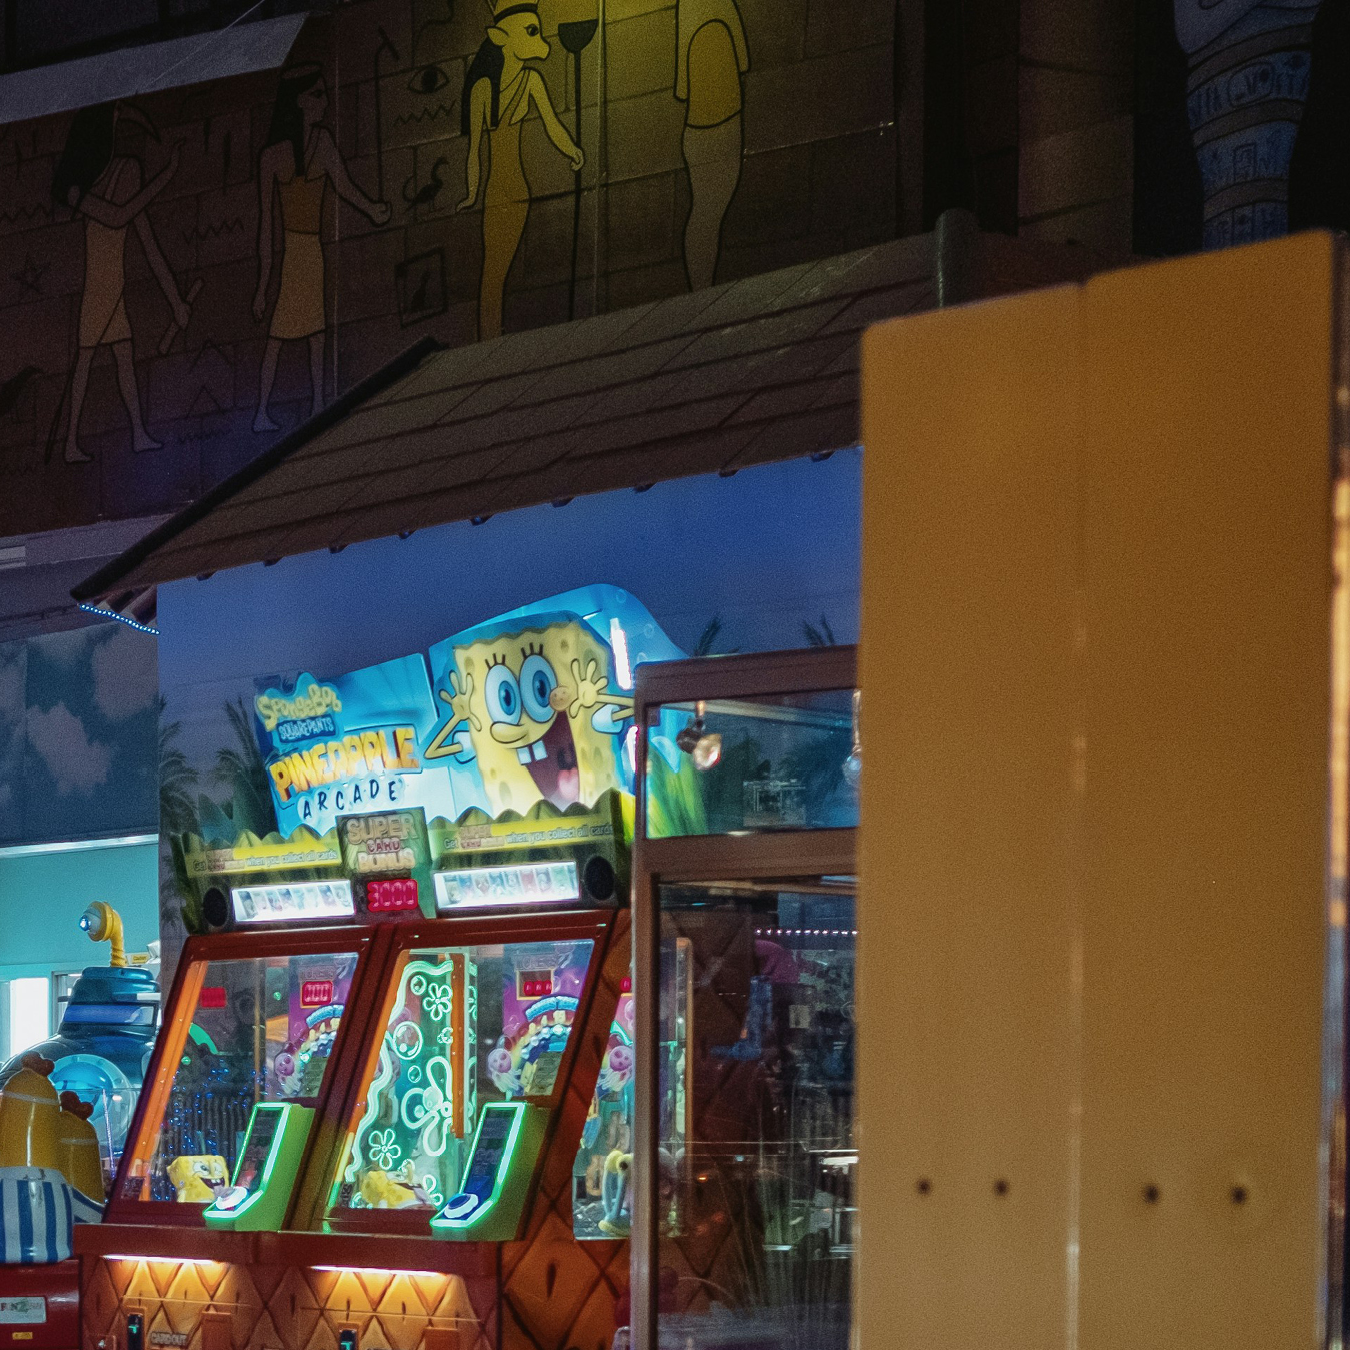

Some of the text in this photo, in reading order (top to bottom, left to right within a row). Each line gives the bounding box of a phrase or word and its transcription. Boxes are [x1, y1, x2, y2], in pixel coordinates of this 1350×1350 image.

[269, 727, 419, 802] PINEAPPLE
[303, 779, 397, 819] ARCADE
[347, 812, 418, 845] SUPER
[357, 848, 415, 873] BONUS
[366, 837, 400, 854] CARD
